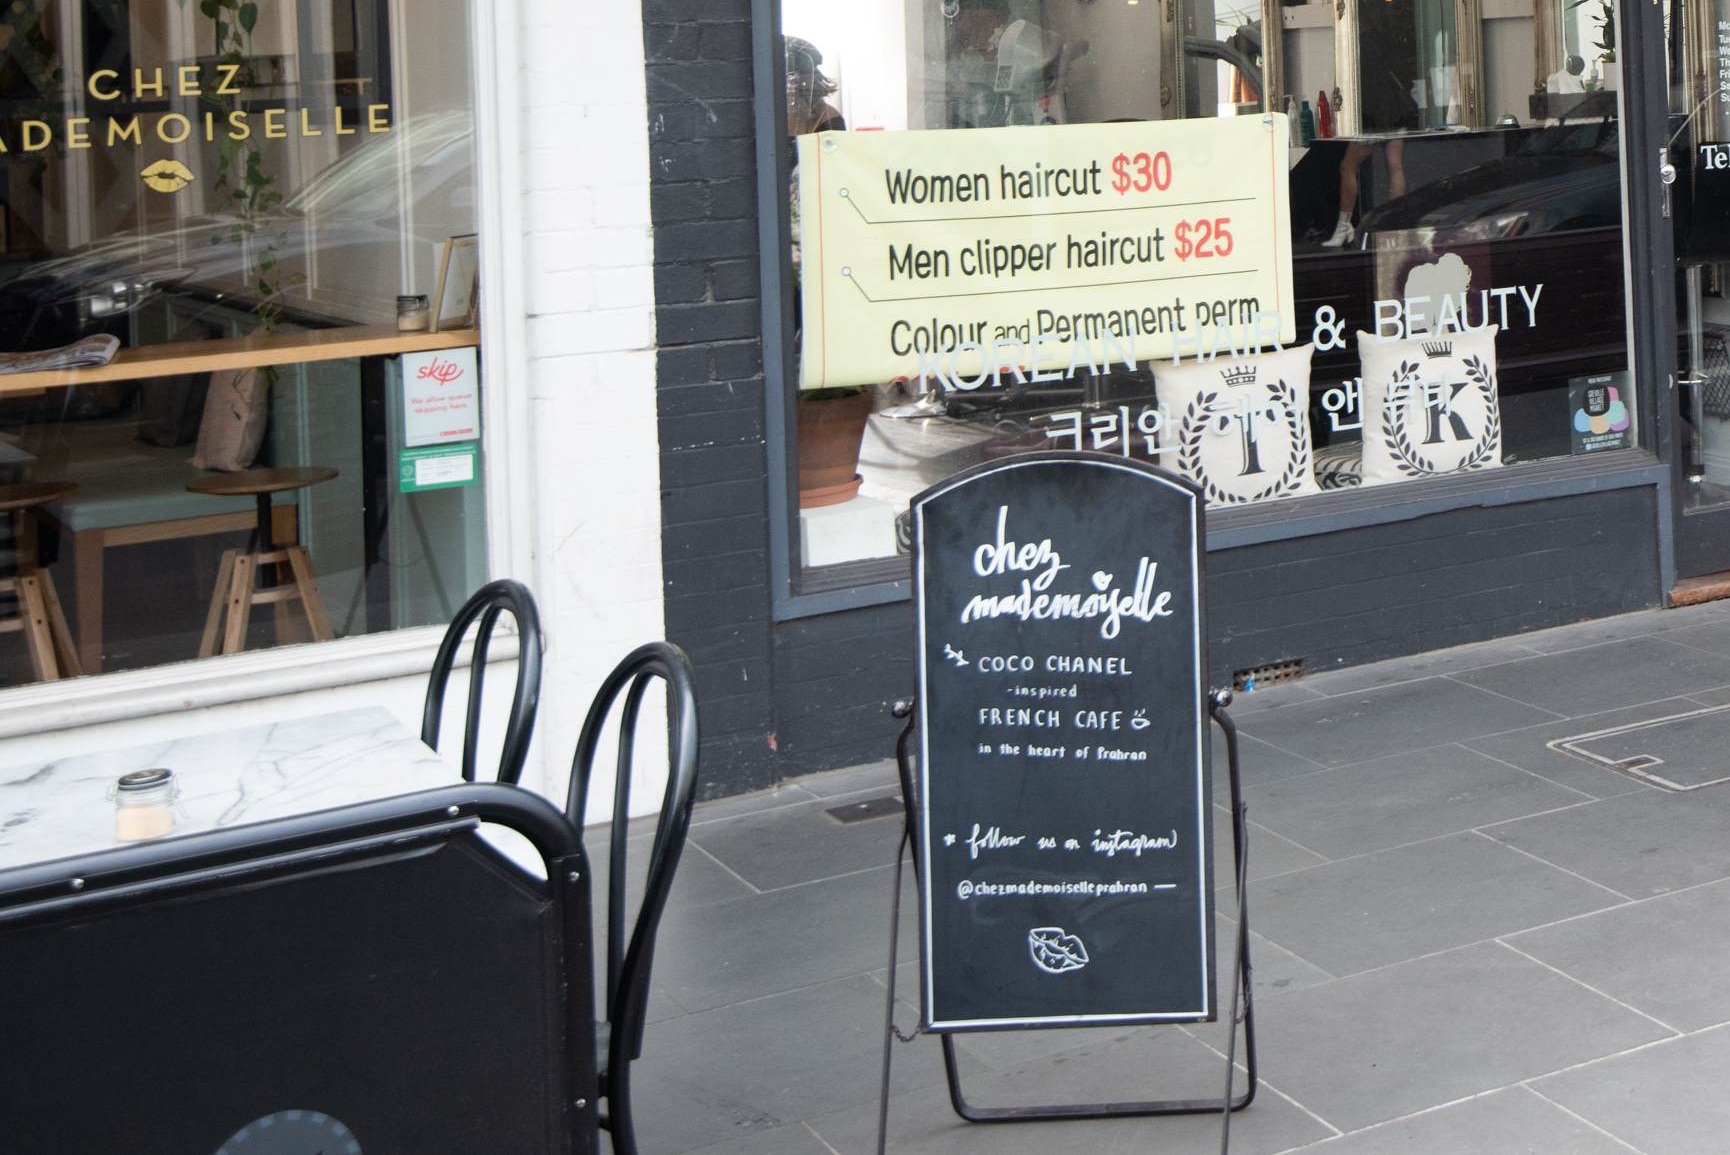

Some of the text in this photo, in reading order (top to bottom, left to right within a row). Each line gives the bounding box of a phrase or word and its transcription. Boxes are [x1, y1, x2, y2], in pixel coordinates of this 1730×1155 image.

[88, 64, 242, 101] CHEZ
[0, 103, 391, 153] DEMOISELLE
[885, 150, 1172, 204] Women haircut $30
[889, 216, 1234, 281] Men clipper haircut $25
[891, 297, 1260, 357] Colour and Permanent perm
[917, 284, 1544, 395] KOREAN HAIR & BEAUTY
[417, 357, 465, 386] skip
[411, 393, 472, 405] We allow queue
[414, 404, 448, 414] skipping
[973, 505, 1071, 591] chez
[977, 655, 1133, 676] COCO CHANEL
[978, 708, 1123, 730] FRENCH CAFE
[978, 743, 1147, 761] in the heart of Prahran
[965, 823, 1177, 860] follow us on instagram
